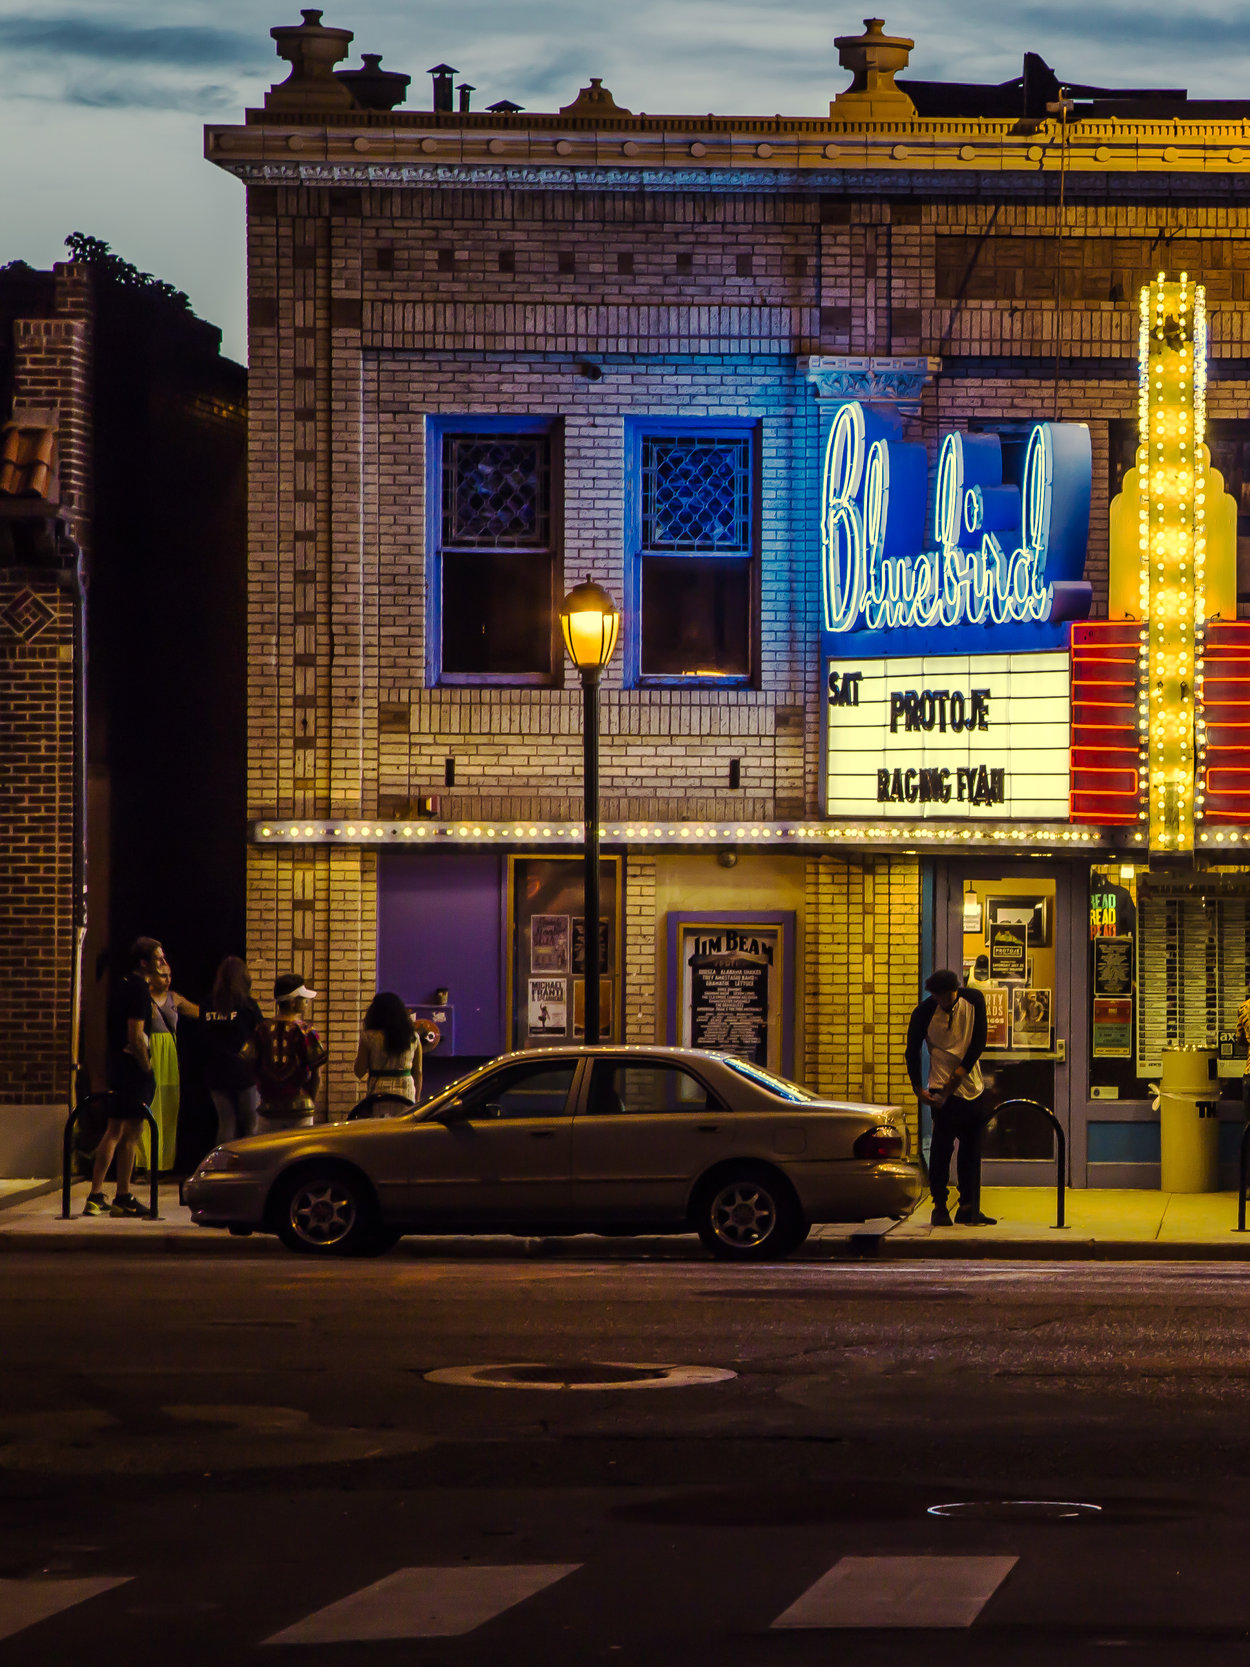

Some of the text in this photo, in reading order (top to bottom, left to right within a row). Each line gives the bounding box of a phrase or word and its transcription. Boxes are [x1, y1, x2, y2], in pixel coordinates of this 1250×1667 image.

[820, 400, 1053, 633] Bluebird
[828, 671, 863, 706] SAT
[890, 688, 991, 733] PROTOJE
[877, 764, 1005, 807] RAGING FYAH
[688, 930, 774, 966] JIM BEAM
[206, 1011, 238, 1021] STAF
[986, 993, 1004, 1004] RTY
[986, 1005, 1004, 1016] ADS
